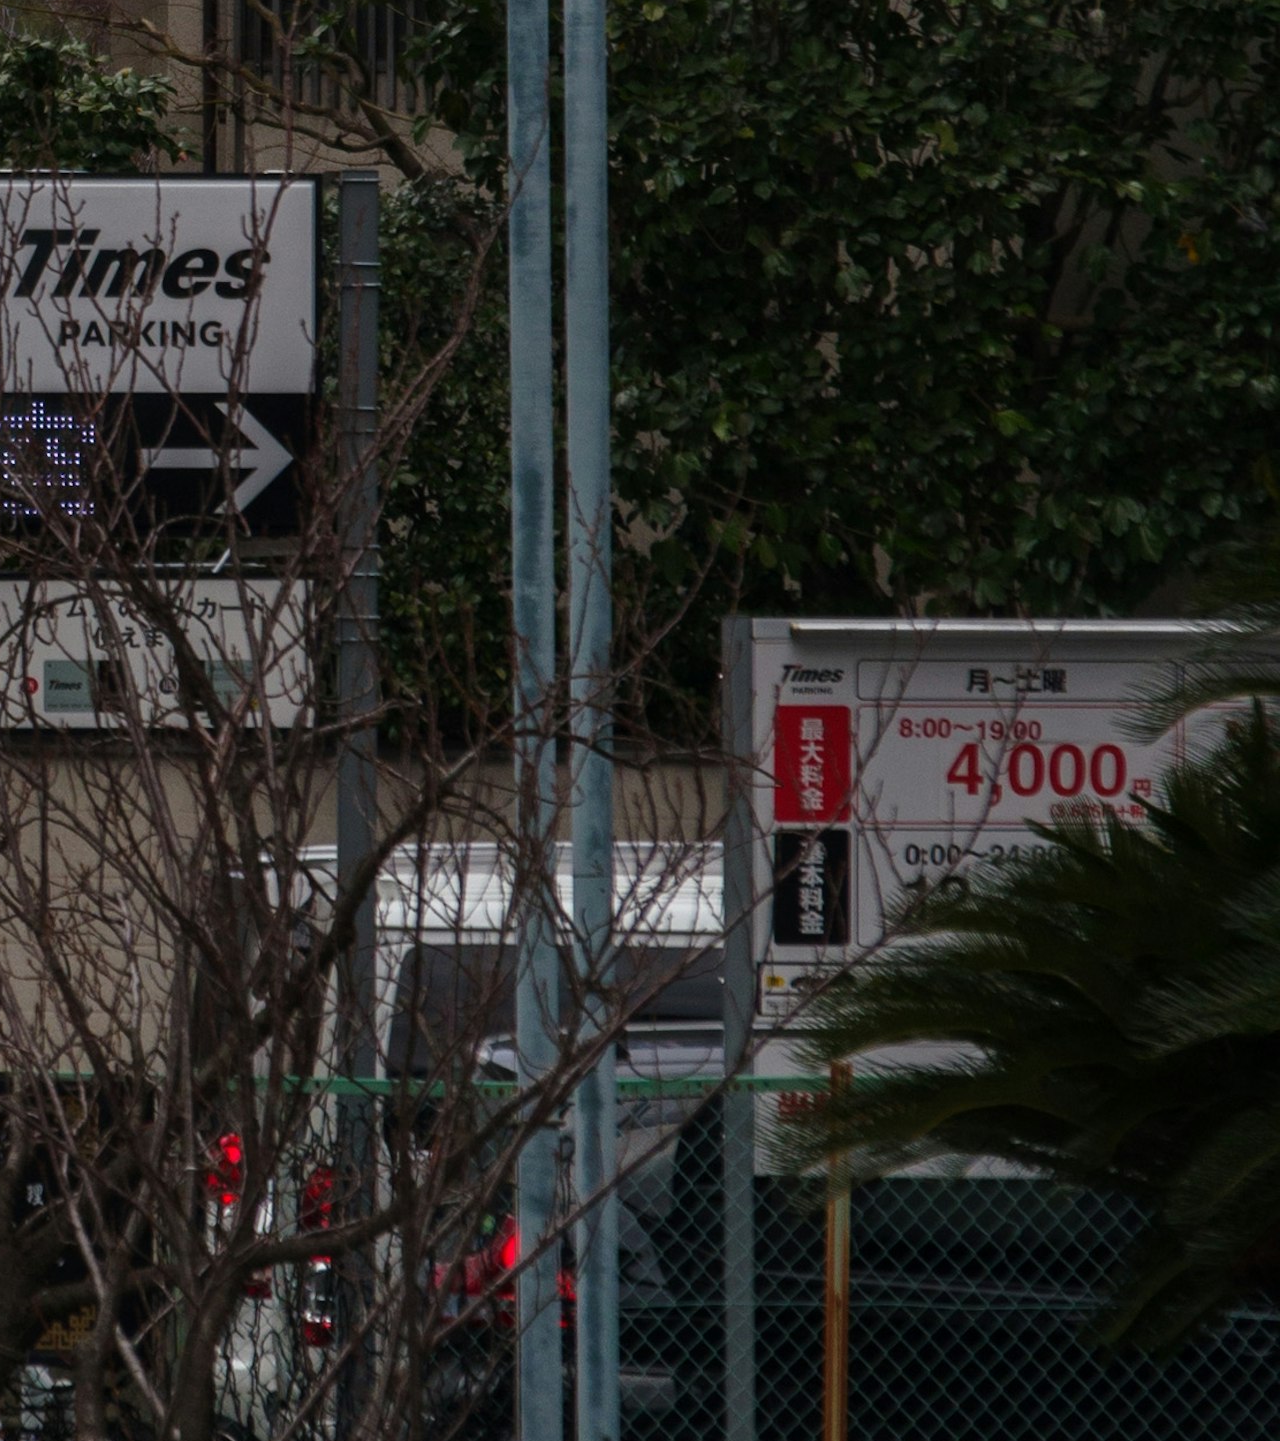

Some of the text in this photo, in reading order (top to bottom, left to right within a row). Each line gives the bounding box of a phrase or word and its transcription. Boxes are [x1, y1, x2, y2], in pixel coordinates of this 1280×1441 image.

[12, 227, 272, 300] Times
[59, 320, 225, 349] PARKING
[781, 663, 845, 683] Times
[799, 717, 825, 812] 最大料金
